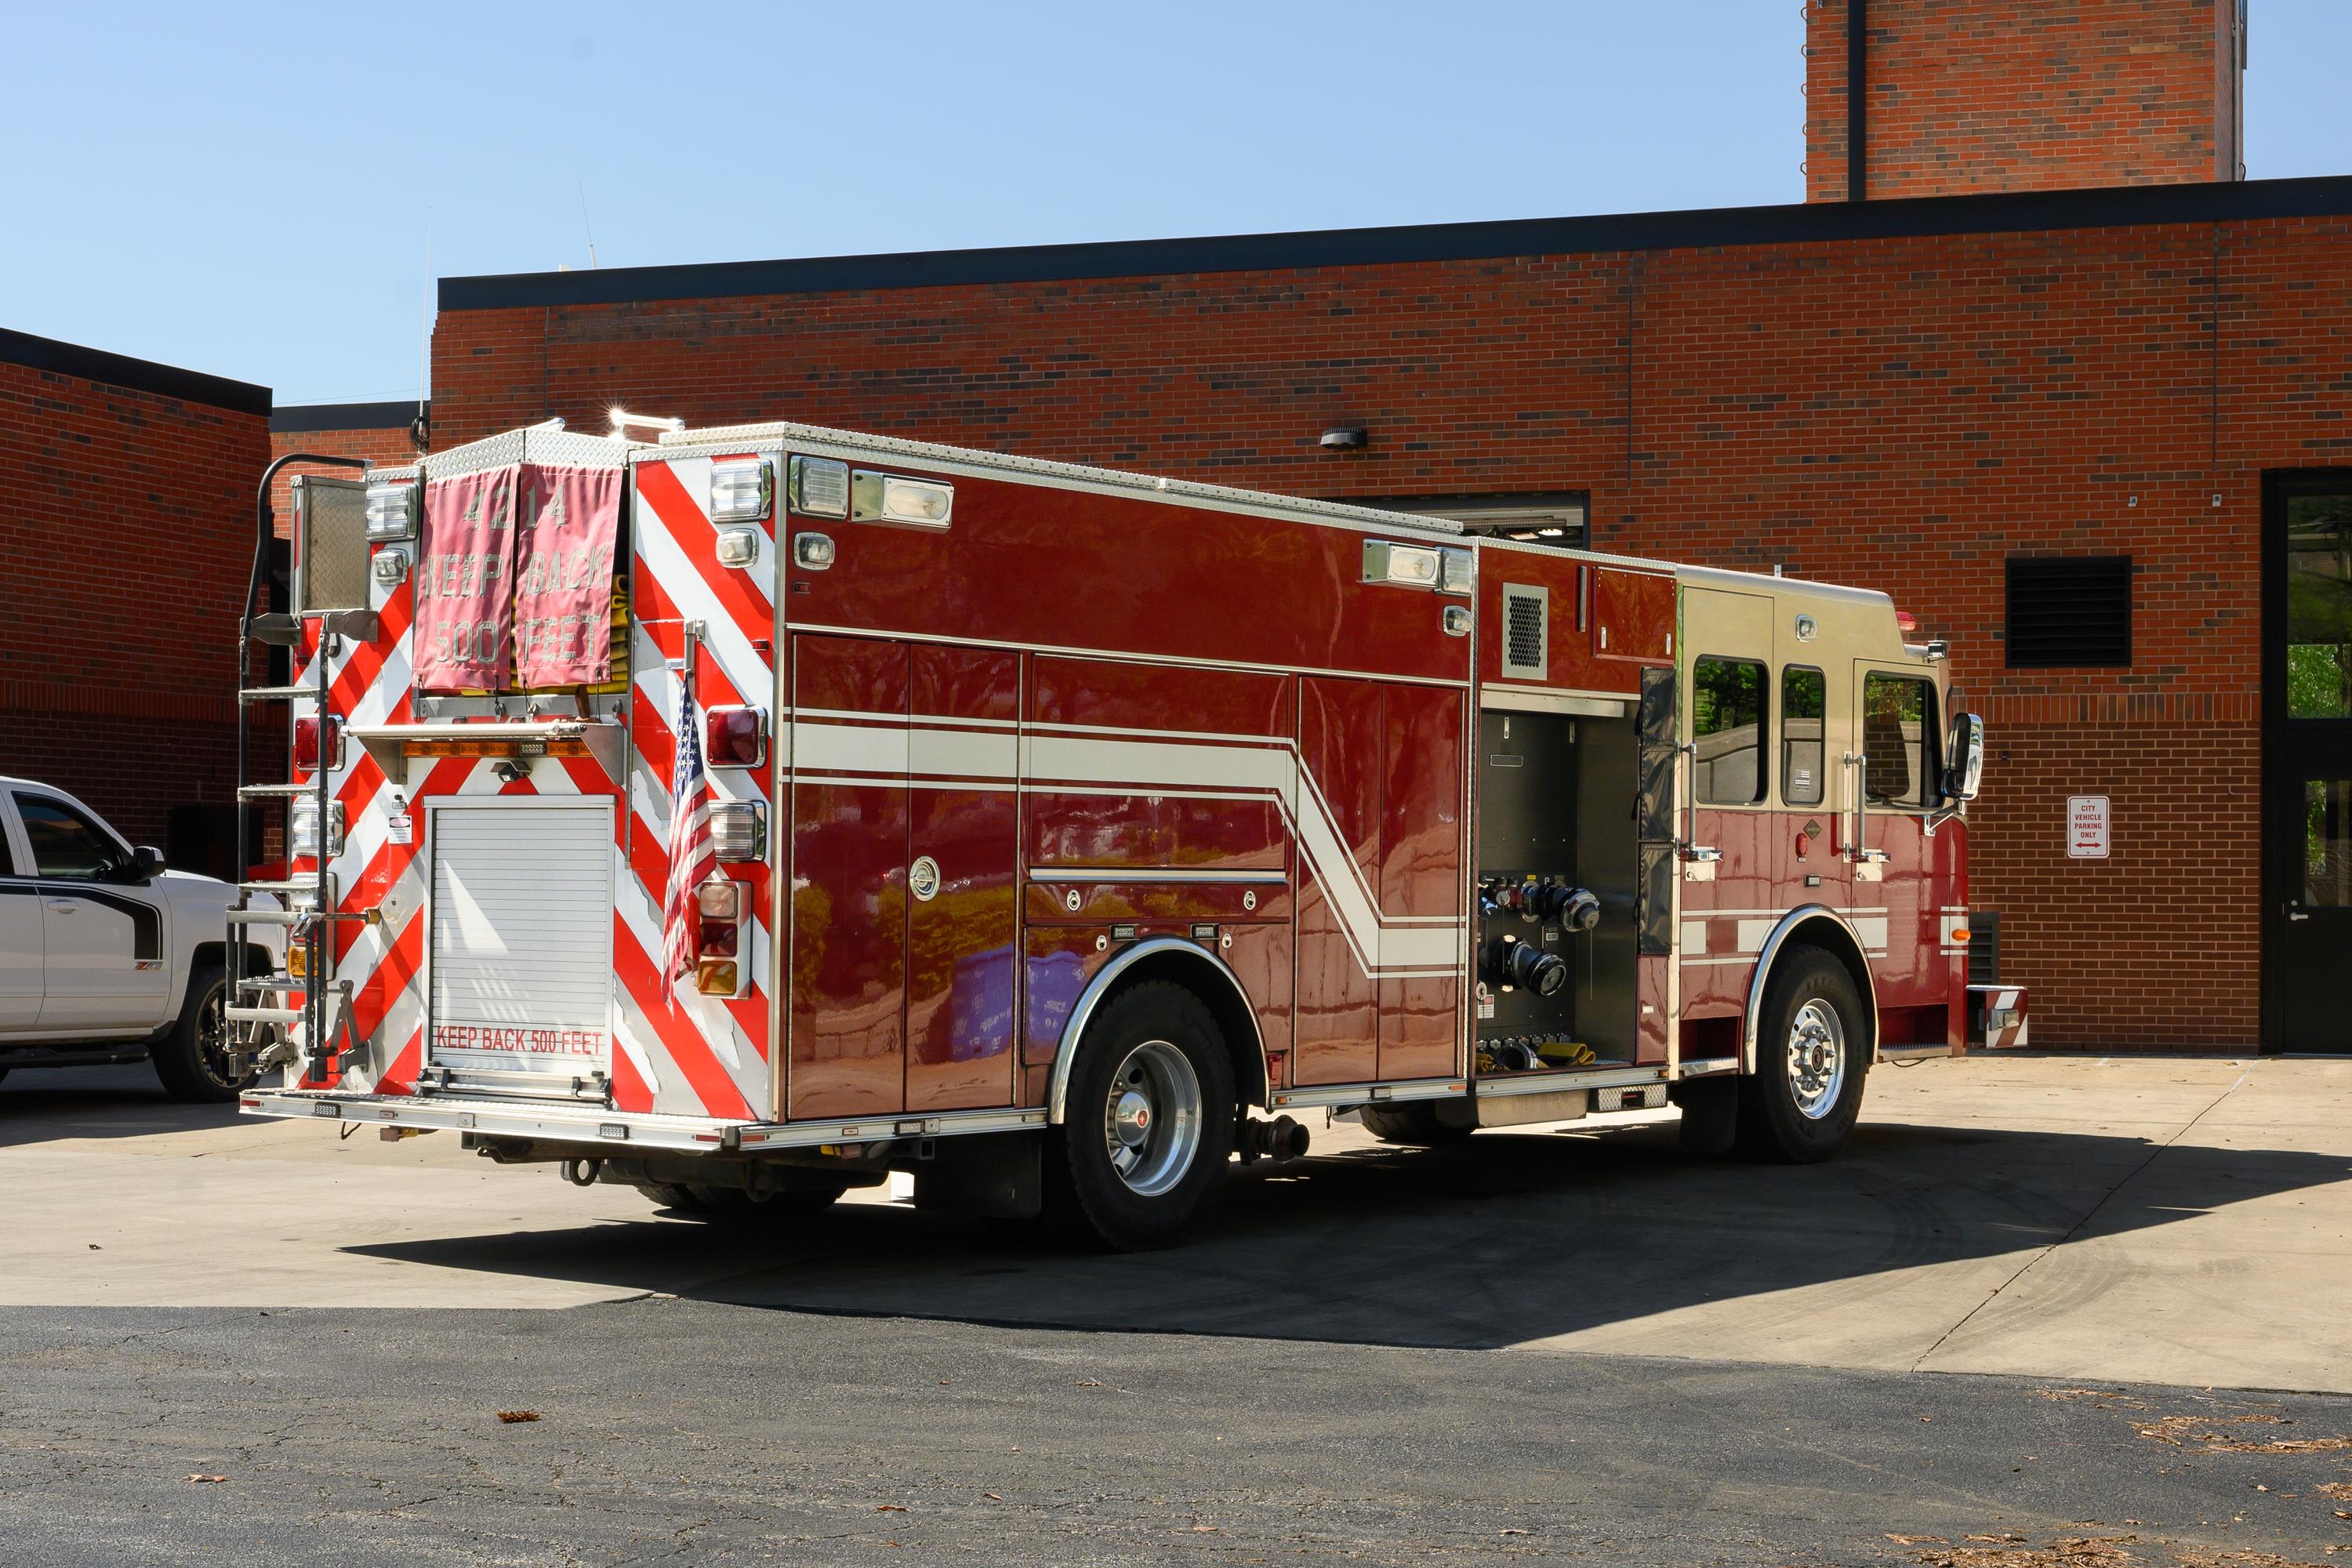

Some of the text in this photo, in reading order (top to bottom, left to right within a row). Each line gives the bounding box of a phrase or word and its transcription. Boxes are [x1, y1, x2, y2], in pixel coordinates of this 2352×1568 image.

[425, 545, 608, 598] KEEP BACK
[436, 613, 602, 664] 500 FEET
[437, 1025, 602, 1054] KEEP BACK 500 FEET
